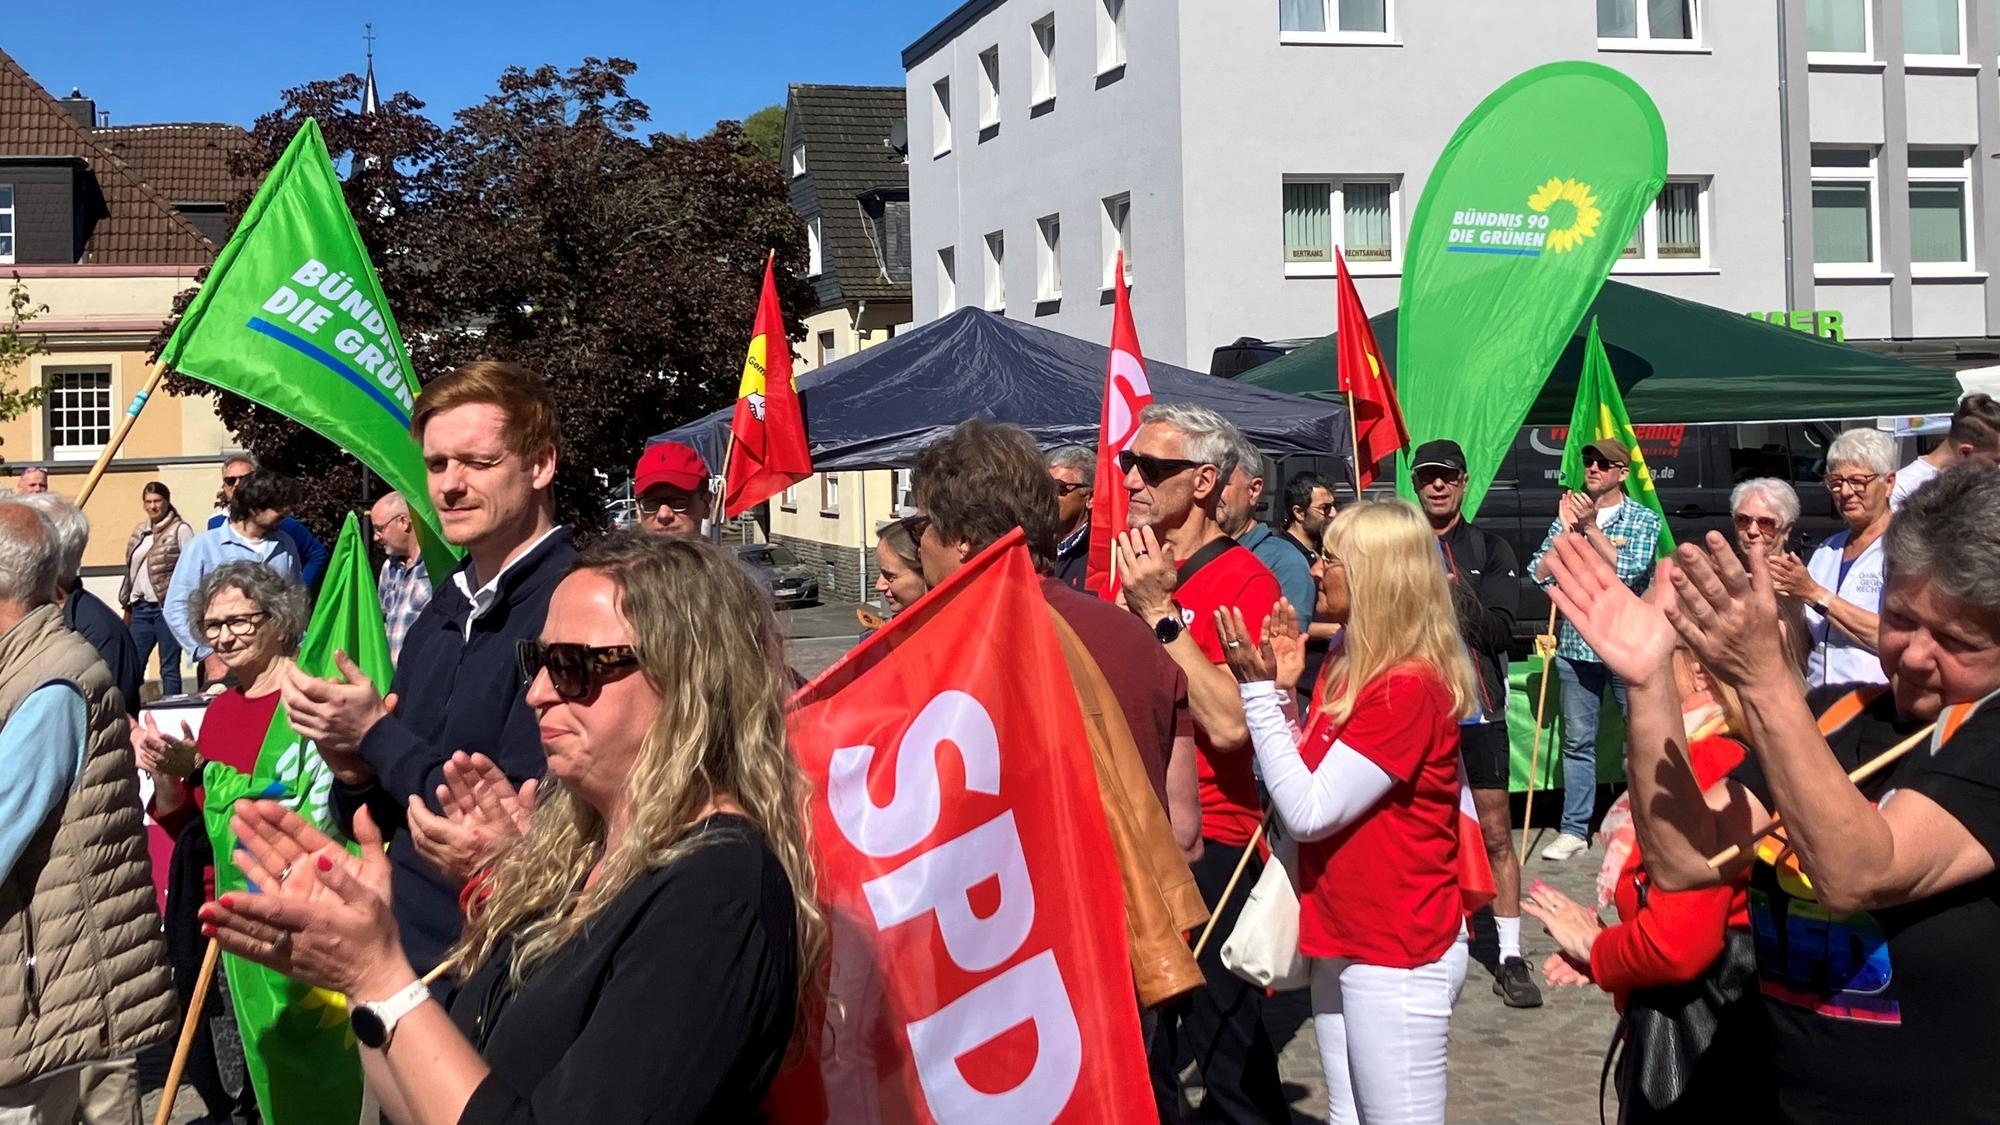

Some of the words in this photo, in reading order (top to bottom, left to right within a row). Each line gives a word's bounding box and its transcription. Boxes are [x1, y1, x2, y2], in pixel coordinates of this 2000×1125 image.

[1452, 208, 1524, 228] BÜNDNIS
[1527, 214, 1549, 229] 90
[1448, 228, 1475, 243] DIE
[1479, 227, 1545, 247] GRÜNEN
[1292, 249, 1324, 258] BERTRAMS
[261, 285, 334, 334] DIE
[828, 689, 1082, 1125] SPD
